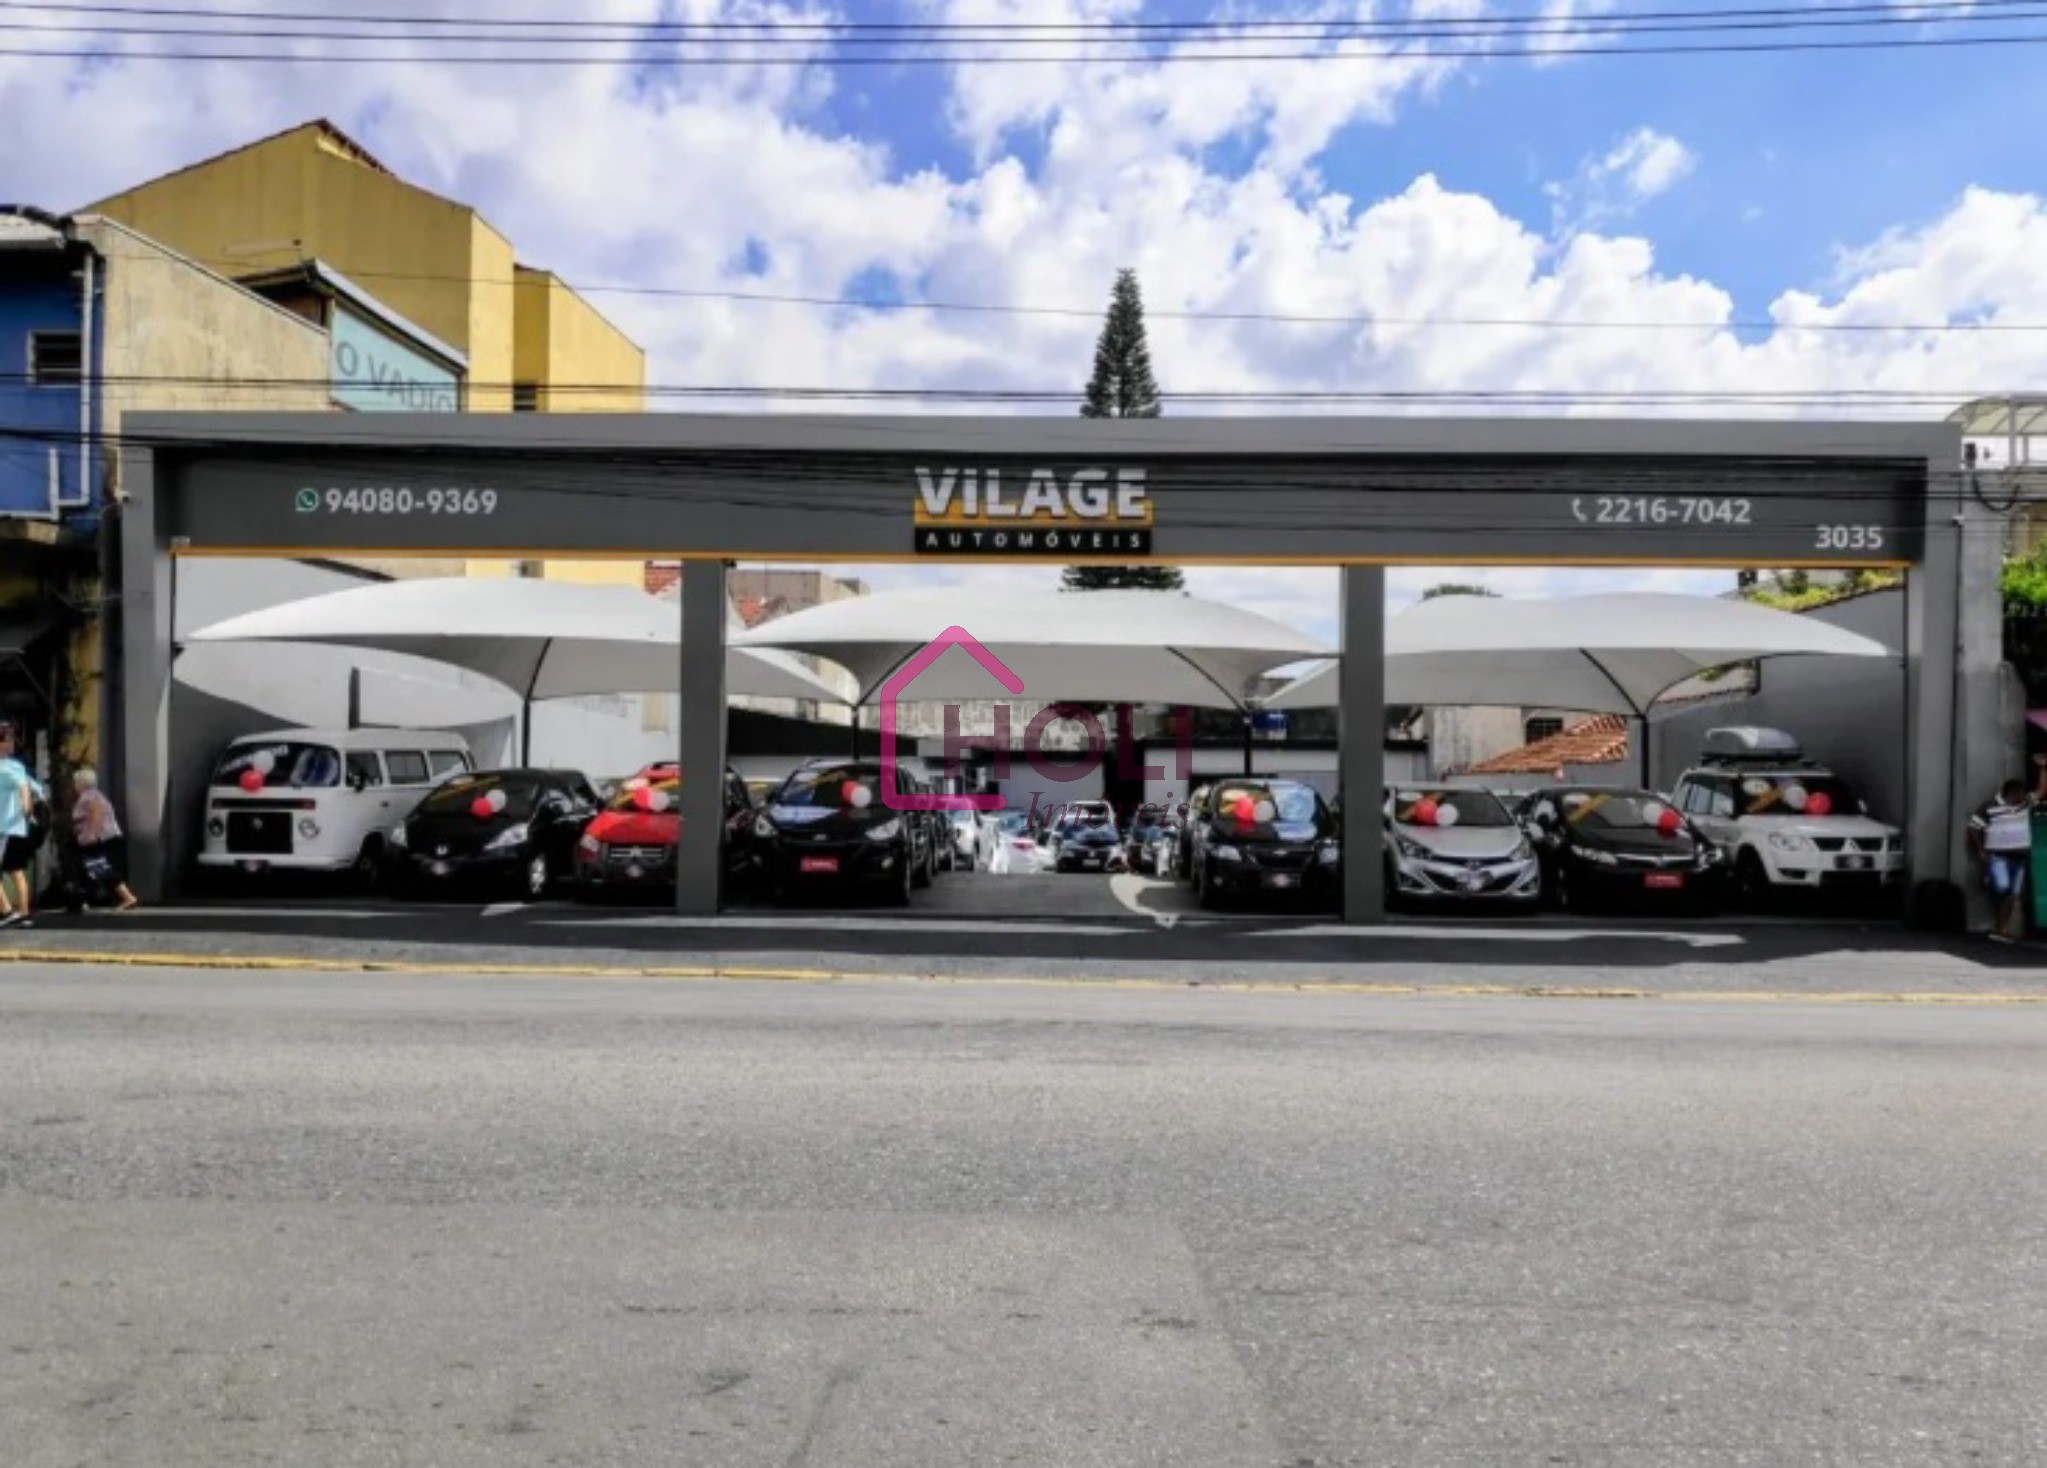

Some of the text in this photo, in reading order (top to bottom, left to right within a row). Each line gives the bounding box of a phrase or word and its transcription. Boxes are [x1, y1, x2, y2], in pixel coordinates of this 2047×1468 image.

[326, 488, 497, 514] 94080-9369
[914, 467, 1148, 518] VILAGE
[1596, 498, 1751, 523] 2216-7042
[926, 530, 1140, 548] AUTOMÓVEIS
[1815, 525, 1883, 548] 3035
